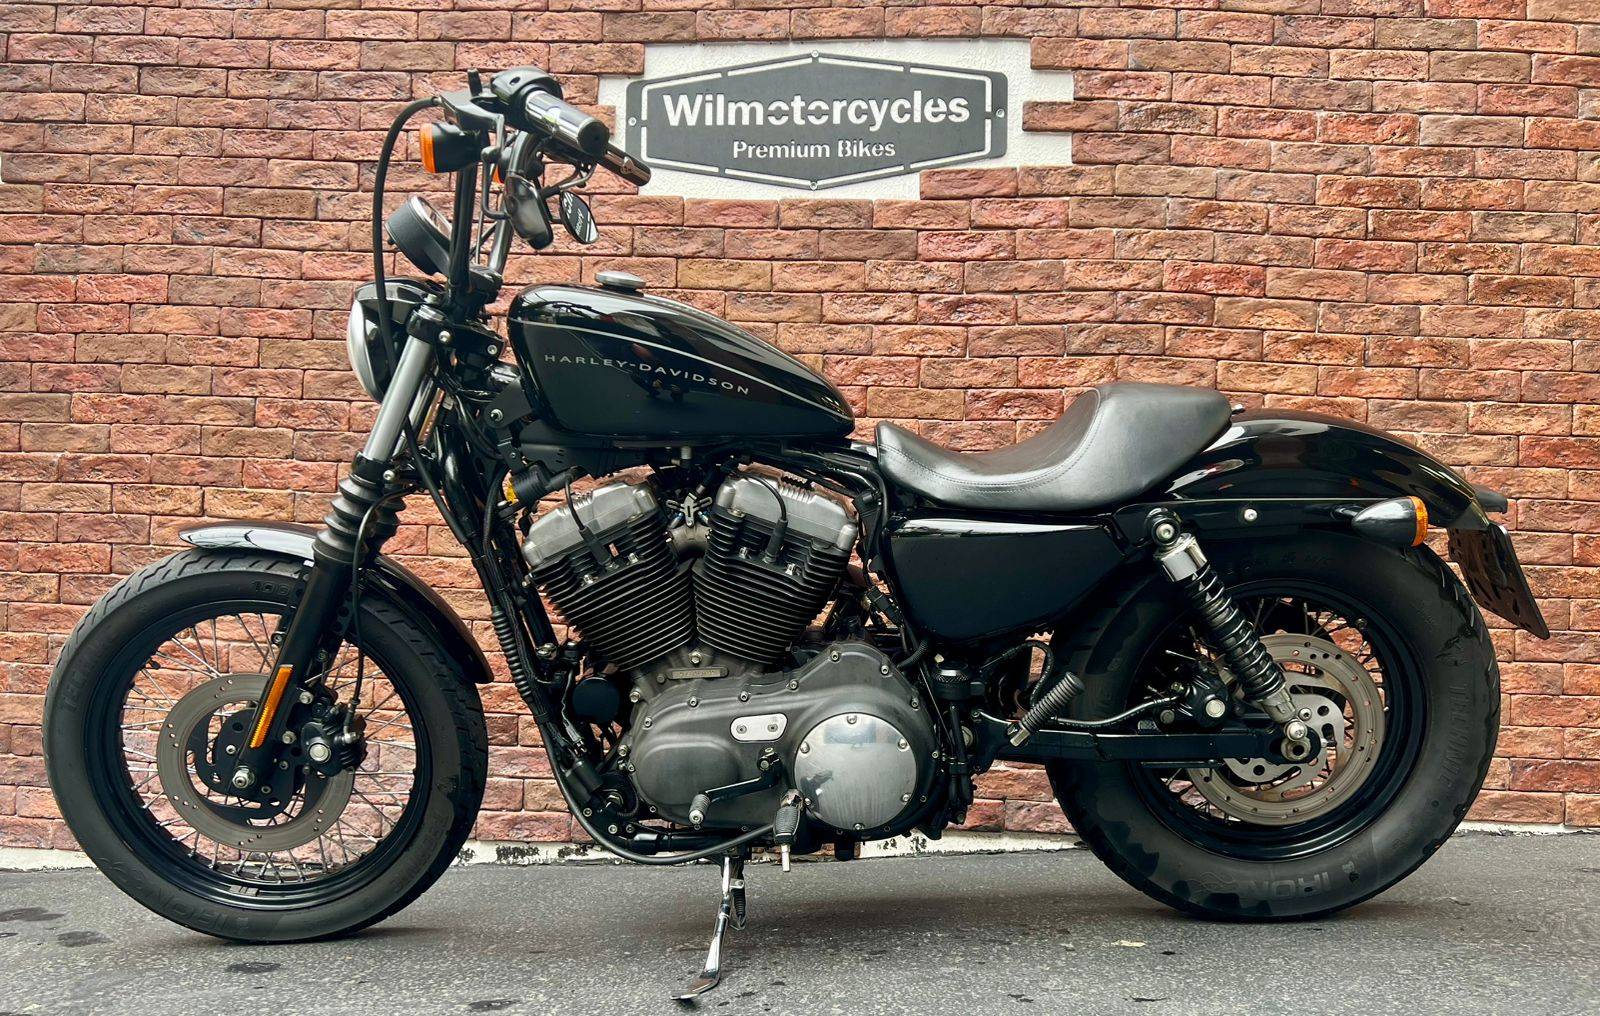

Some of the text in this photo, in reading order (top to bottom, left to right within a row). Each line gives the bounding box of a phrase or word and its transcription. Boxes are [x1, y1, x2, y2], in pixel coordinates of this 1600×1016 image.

[662, 90, 970, 131] Wilmotorcycles
[732, 138, 897, 159] Premium Bikes
[543, 353, 750, 395] HARLEY-DAVIDSON
